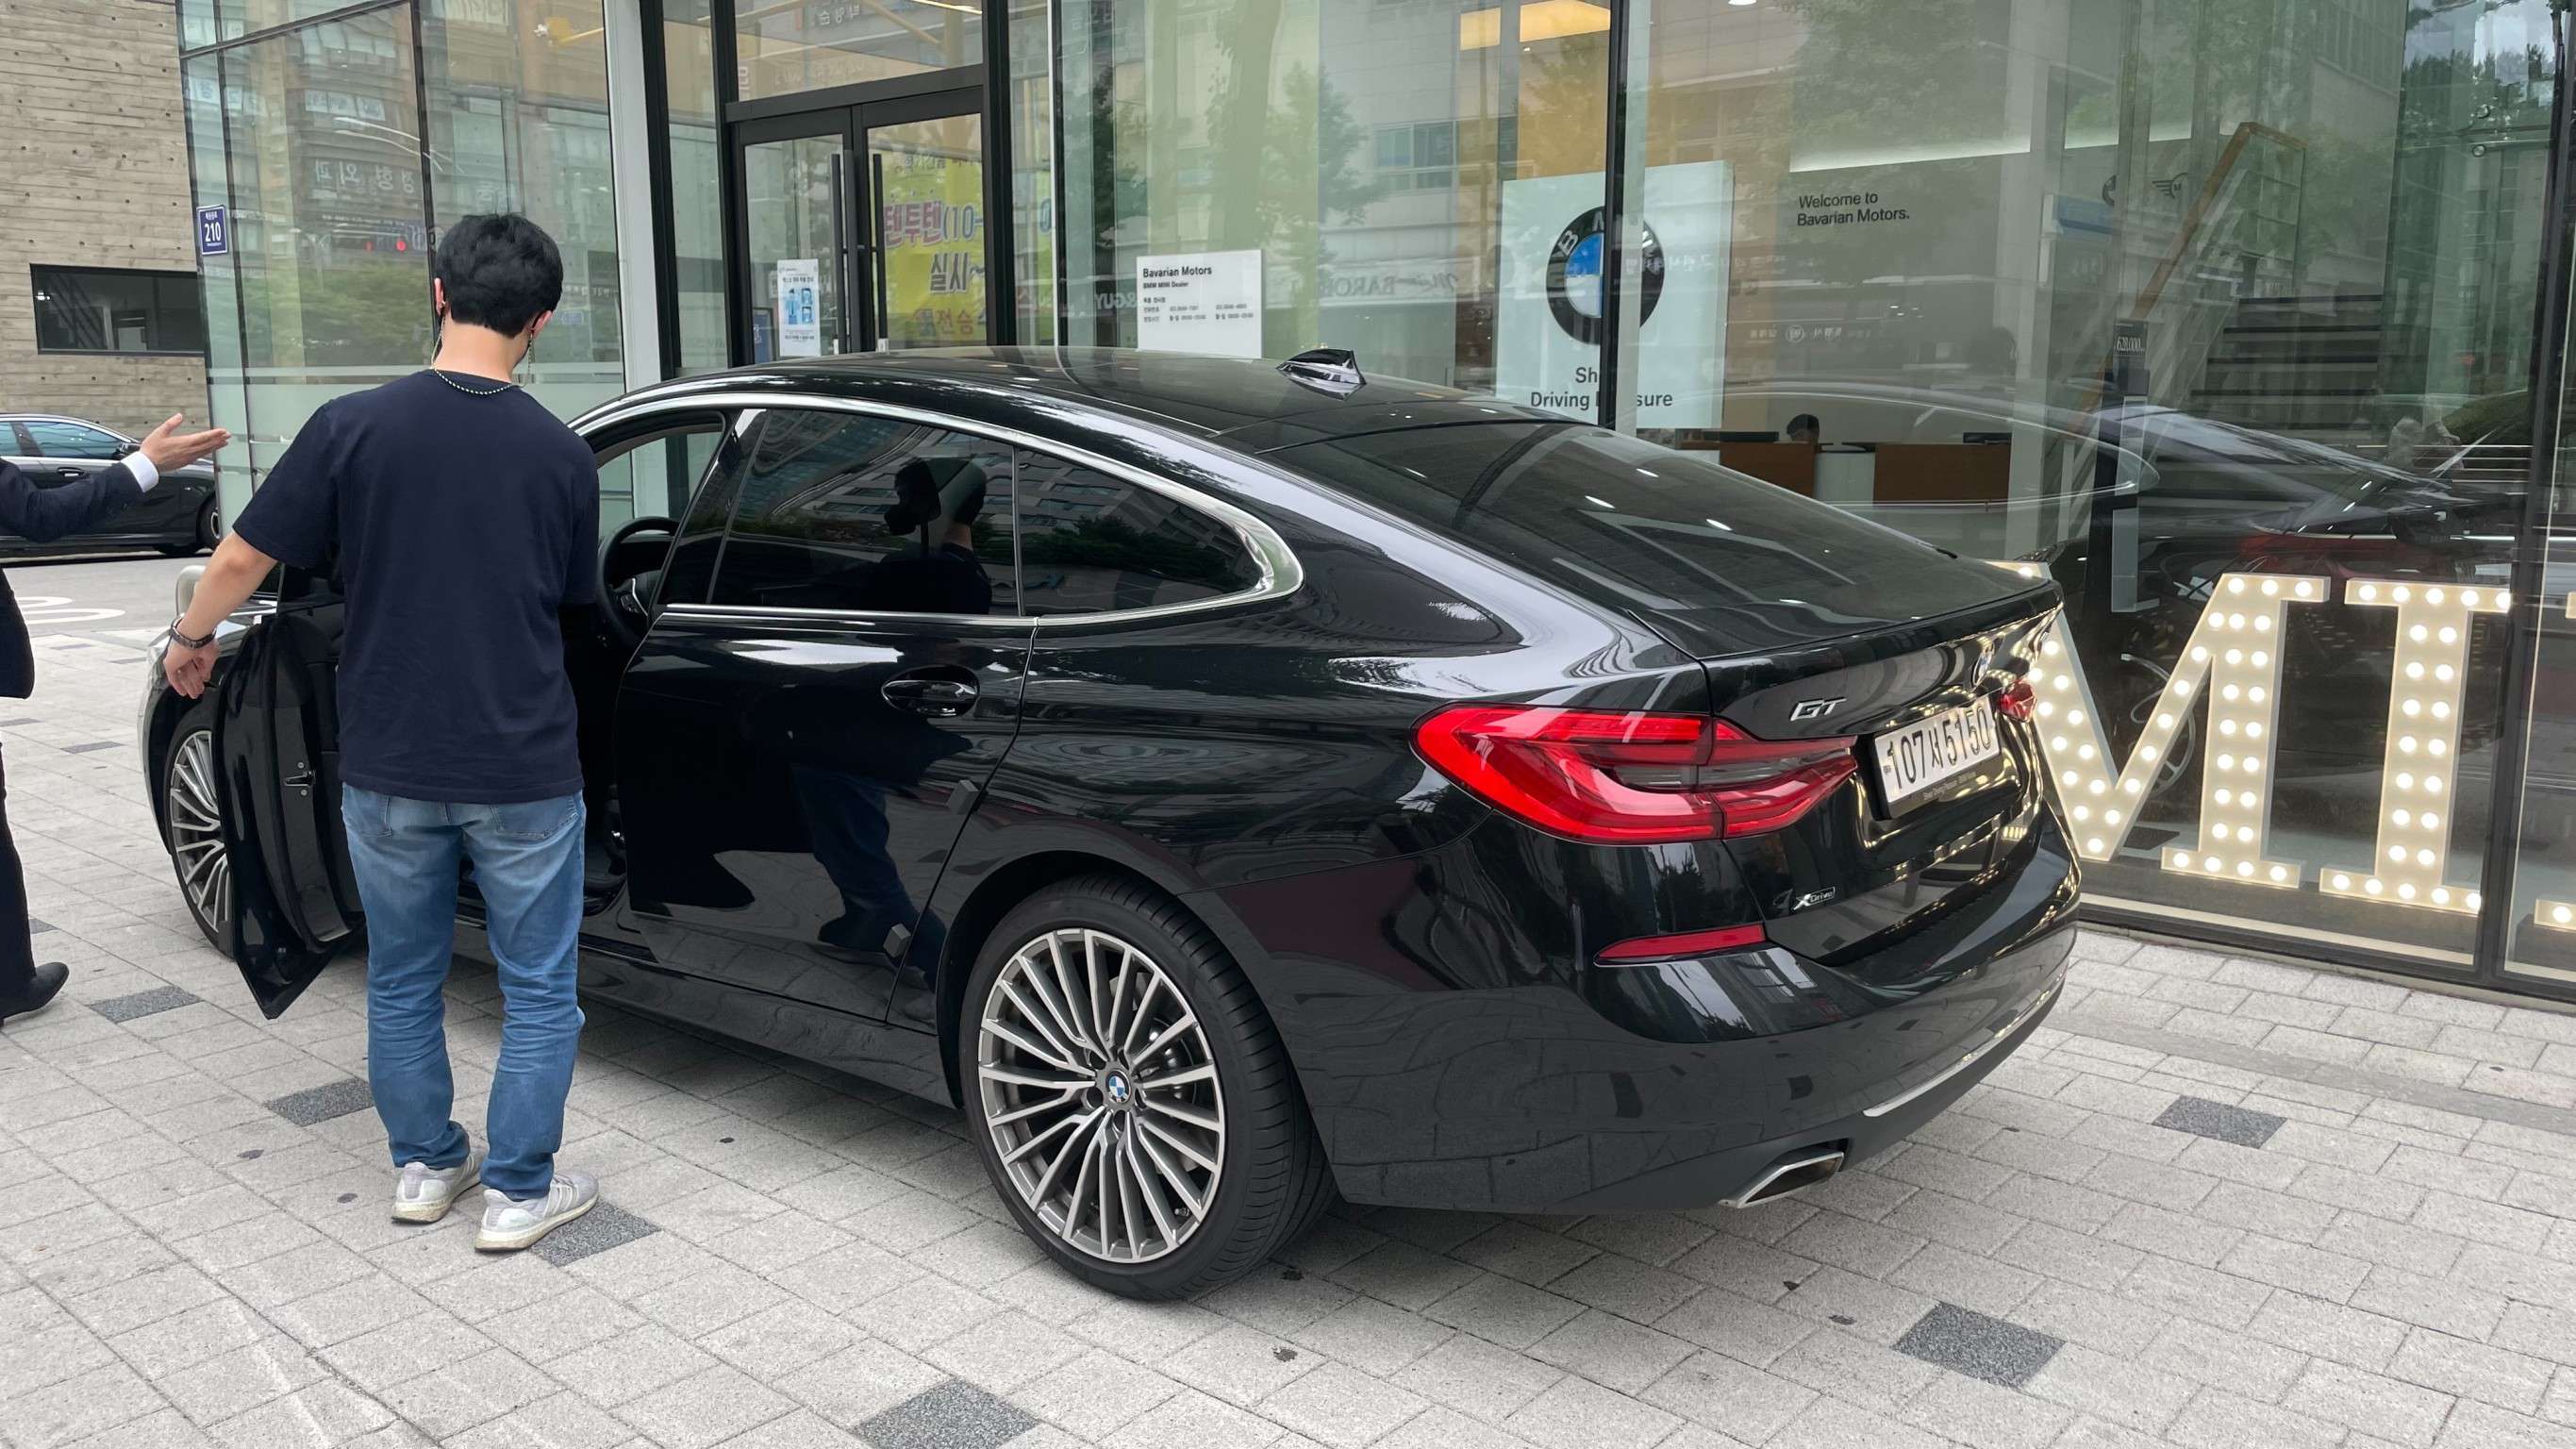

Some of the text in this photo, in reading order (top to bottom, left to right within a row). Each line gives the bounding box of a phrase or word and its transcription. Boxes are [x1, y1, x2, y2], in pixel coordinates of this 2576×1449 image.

[1799, 192, 1878, 208] Welcome to
[1797, 208, 1910, 226] Bavarian Motors.
[205, 222, 222, 242] 210
[1143, 265, 1212, 278] Bavarian Motors
[1531, 391, 1590, 410] Driving
[1789, 698, 1847, 721] GT
